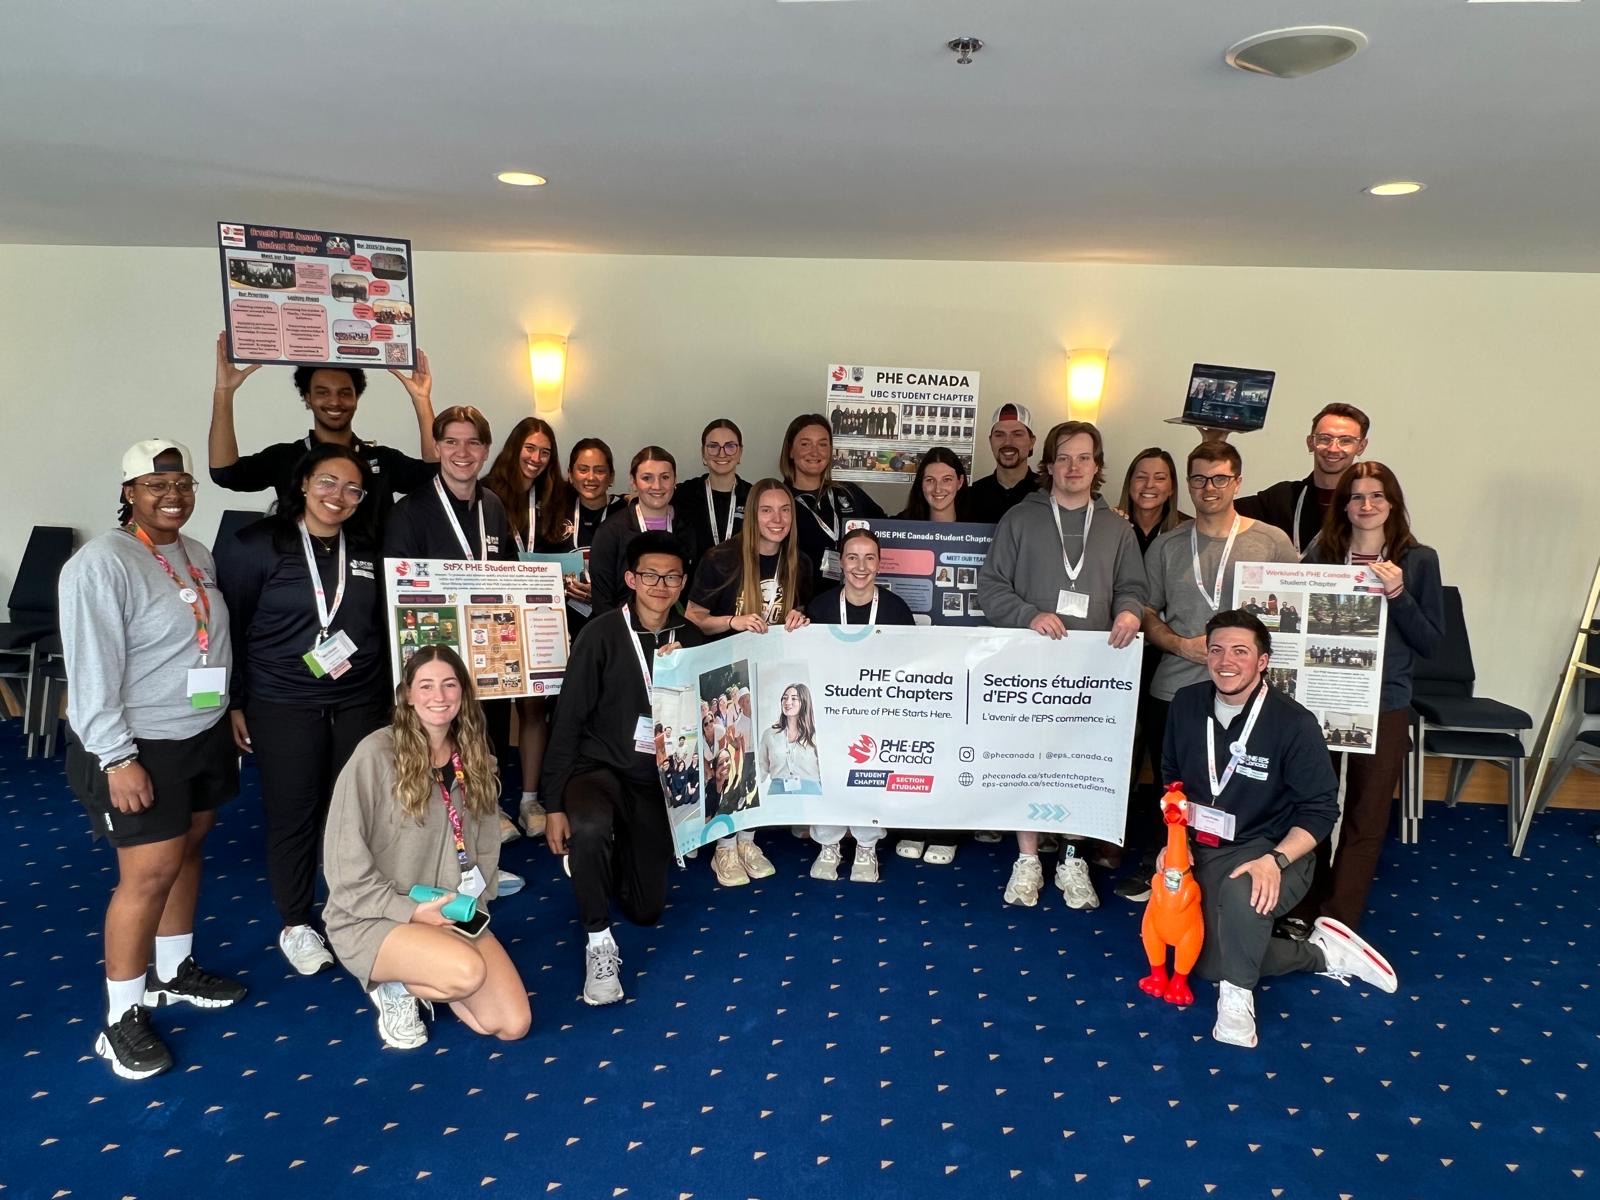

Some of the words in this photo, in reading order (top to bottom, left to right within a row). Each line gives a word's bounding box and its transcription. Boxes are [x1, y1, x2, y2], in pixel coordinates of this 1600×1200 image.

[876, 372, 904, 384] PHE
[906, 374, 970, 387] CANADA
[870, 390, 889, 398] UBC
[891, 392, 931, 400] STUDENT
[932, 394, 974, 402] CHAPTER
[892, 531, 906, 539] PHE
[907, 532, 934, 540] Canada
[935, 533, 964, 542] Student
[443, 563, 463, 571] StFX
[465, 564, 482, 572] PHE
[484, 564, 516, 572] Student
[518, 565, 548, 574] Chapter
[859, 669, 892, 682] PHE
[895, 670, 953, 685] Canada
[983, 674, 1048, 688] Sections
[1051, 674, 1133, 691] étudiantes
[824, 684, 882, 698] Student
[886, 686, 953, 702] Chapters
[1032, 692, 1092, 705] Canada
[824, 706, 840, 715] The
[841, 707, 869, 715] Future
[870, 708, 881, 716] of
[881, 708, 901, 716] PHE
[902, 708, 928, 718] Starts
[930, 710, 953, 719] Here.
[982, 712, 1018, 722] L'avenir
[1018, 713, 1030, 722] de
[879, 750, 932, 764] Canada
[982, 751, 1035, 760] @phecanada
[1046, 751, 1113, 762] @eps_canada.ca
[982, 772, 1105, 784] phecanada.ca/studentchapters
[982, 781, 1116, 795] eps-canada.ca/sectionsetudiantes
